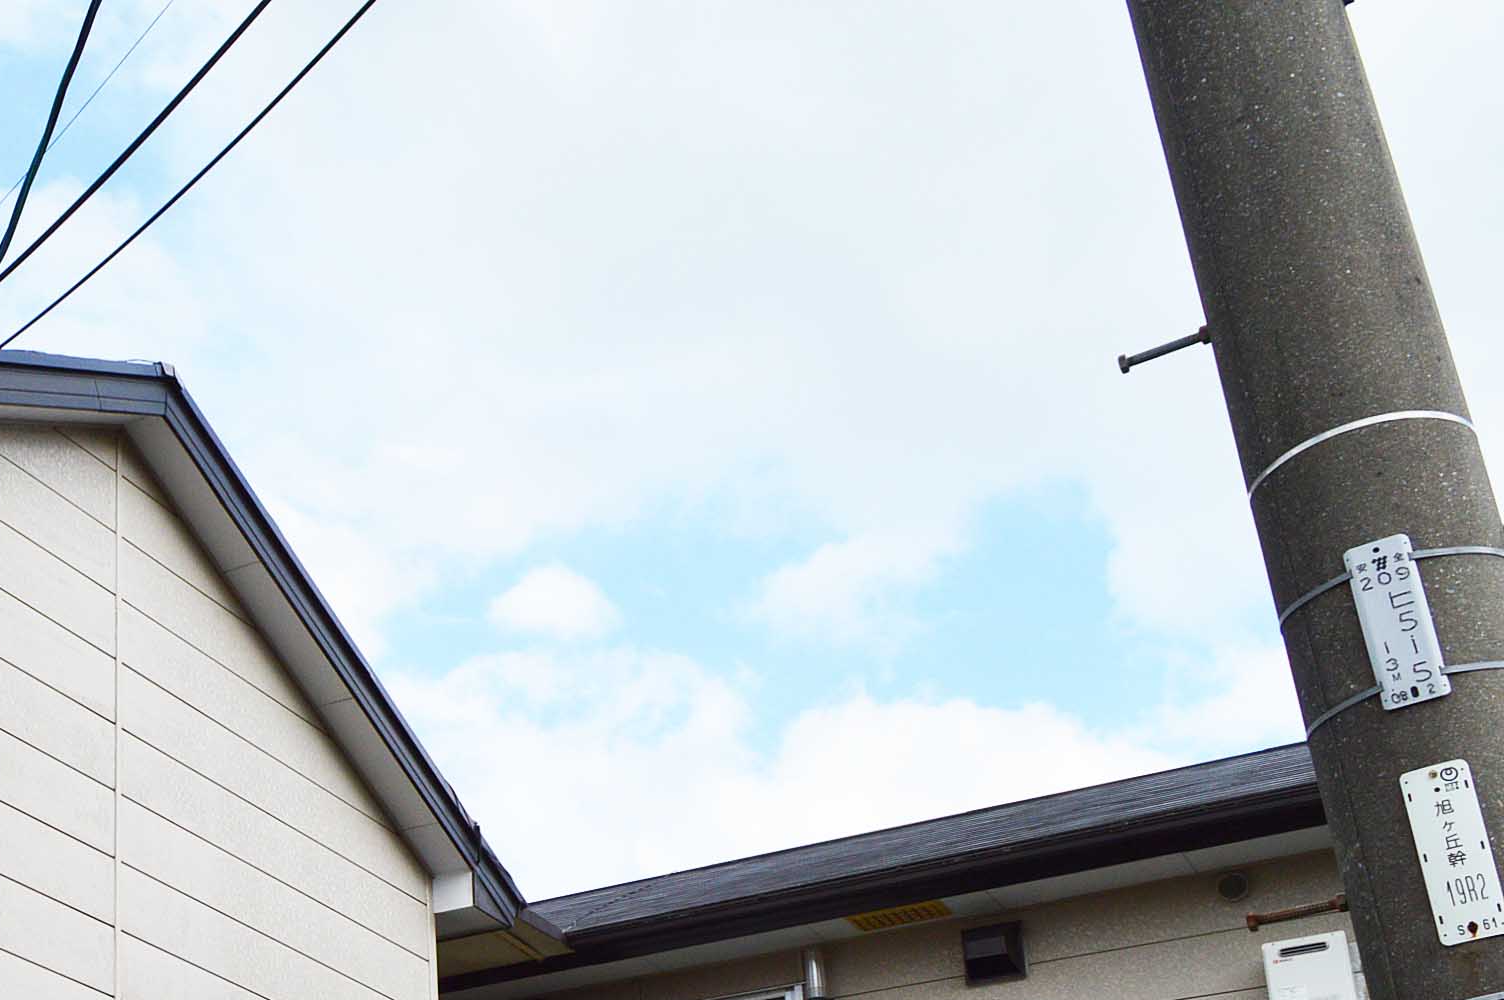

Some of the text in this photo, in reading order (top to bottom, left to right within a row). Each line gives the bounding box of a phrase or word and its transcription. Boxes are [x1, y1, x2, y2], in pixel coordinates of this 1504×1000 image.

[1360, 566, 1410, 591] 209
[1427, 683, 1437, 694] 2
[1446, 873, 1489, 907] 19R2
[1457, 925, 1466, 936] S
